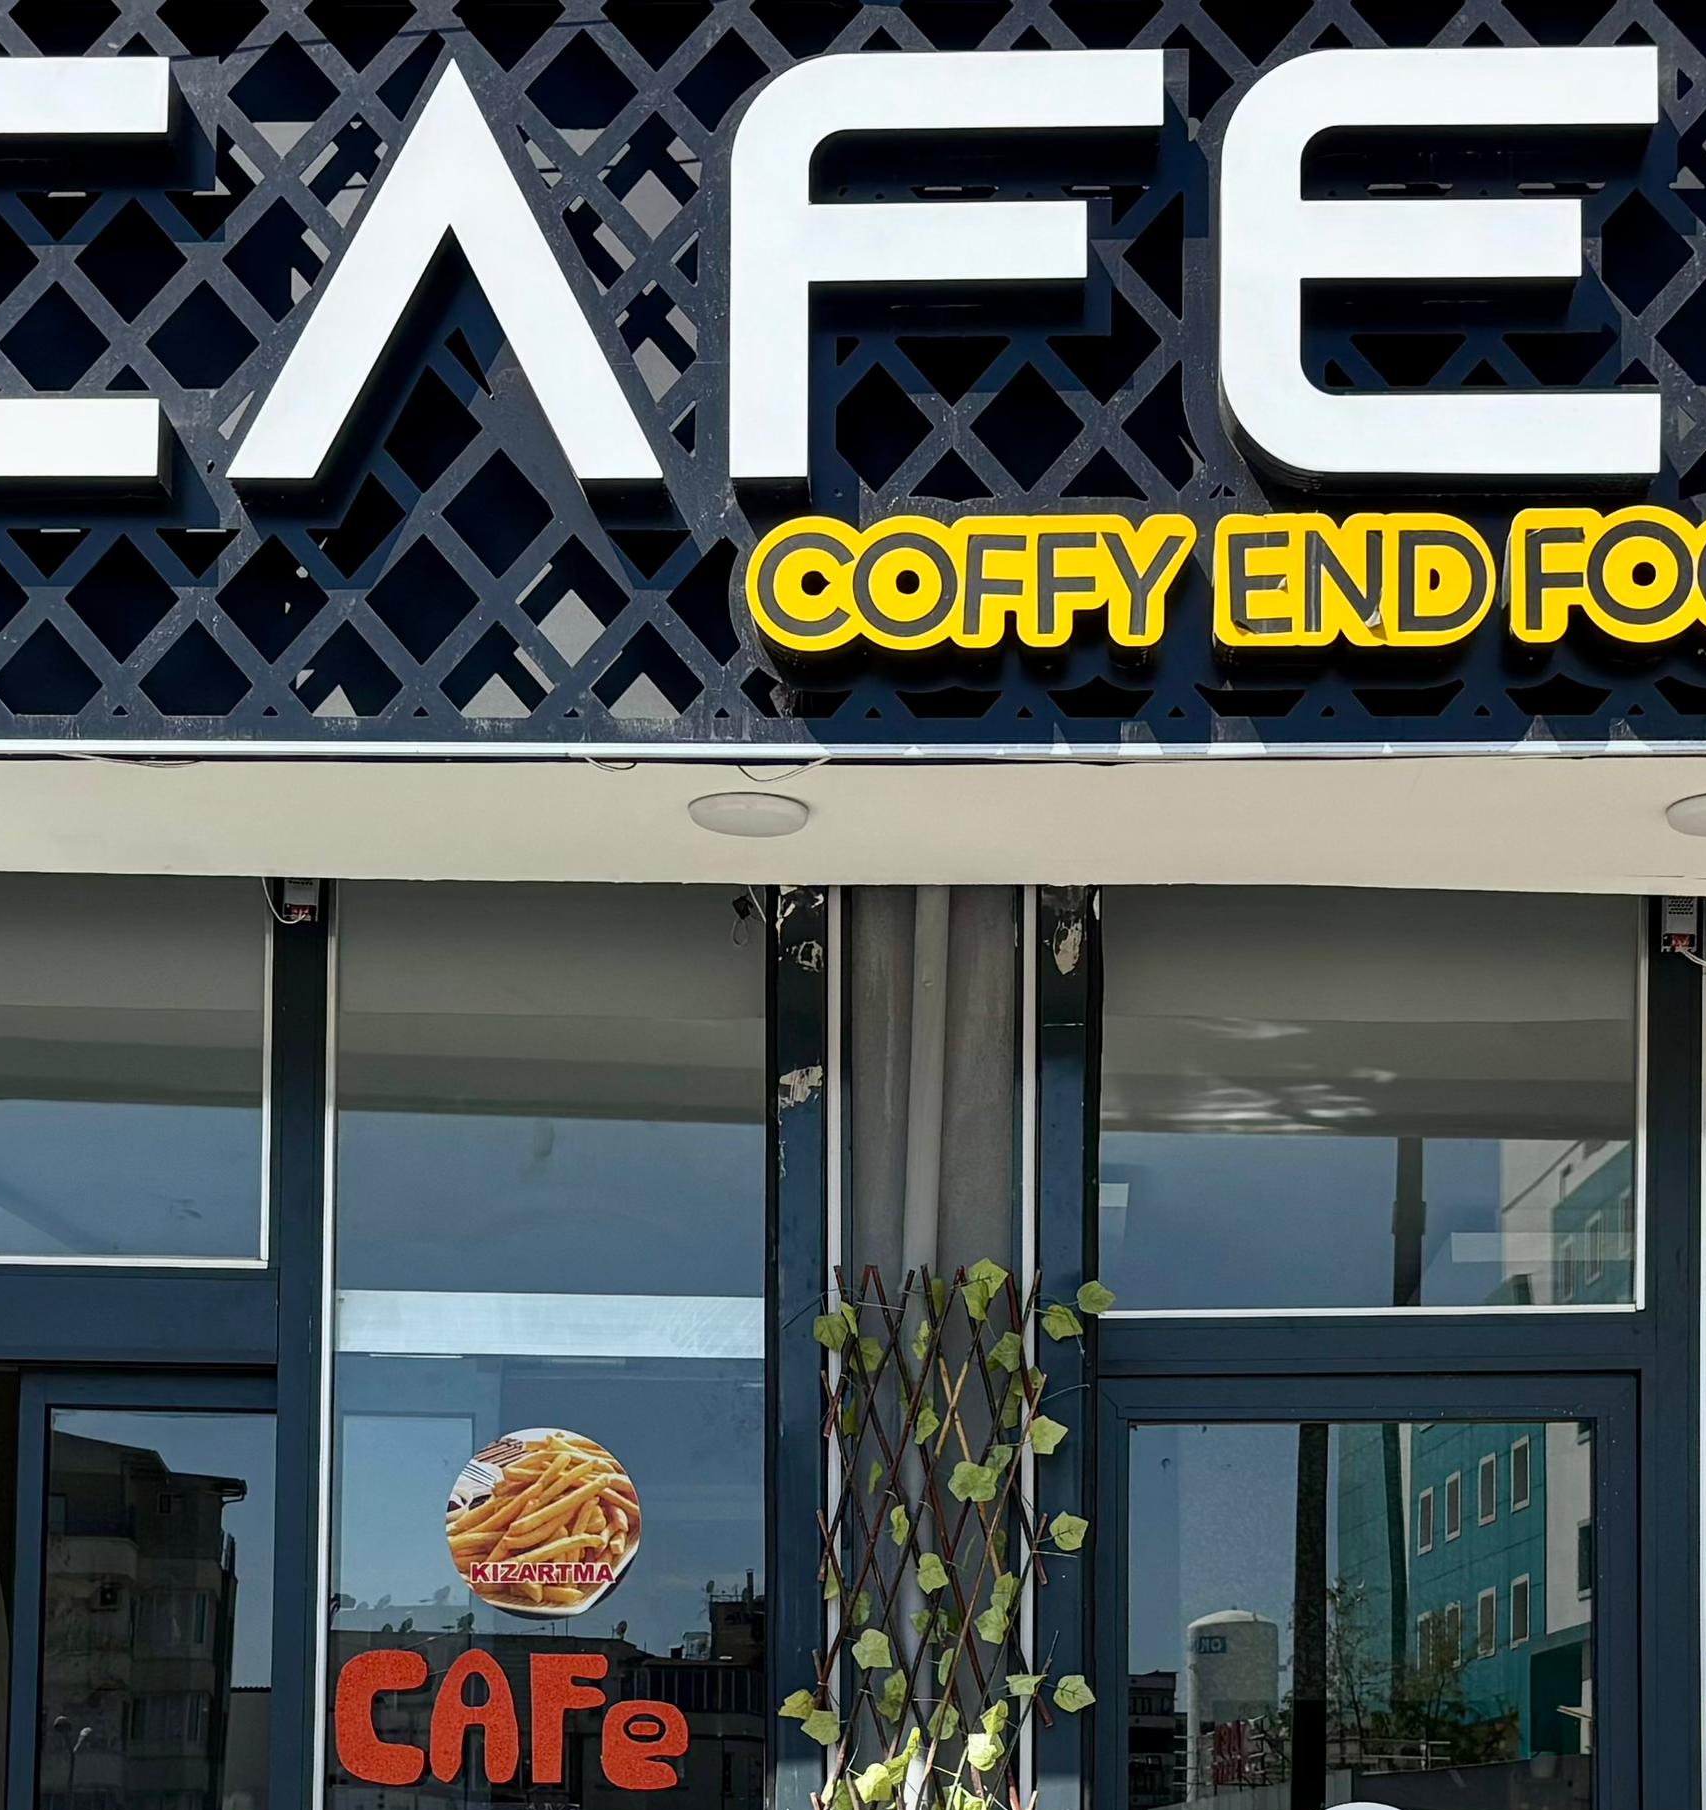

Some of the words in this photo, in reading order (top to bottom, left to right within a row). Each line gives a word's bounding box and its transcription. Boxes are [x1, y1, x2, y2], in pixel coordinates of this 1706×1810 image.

[747, 514, 1196, 652] COFFY
[1213, 512, 1496, 648] END
[470, 1561, 615, 1585] KIZARTMA
